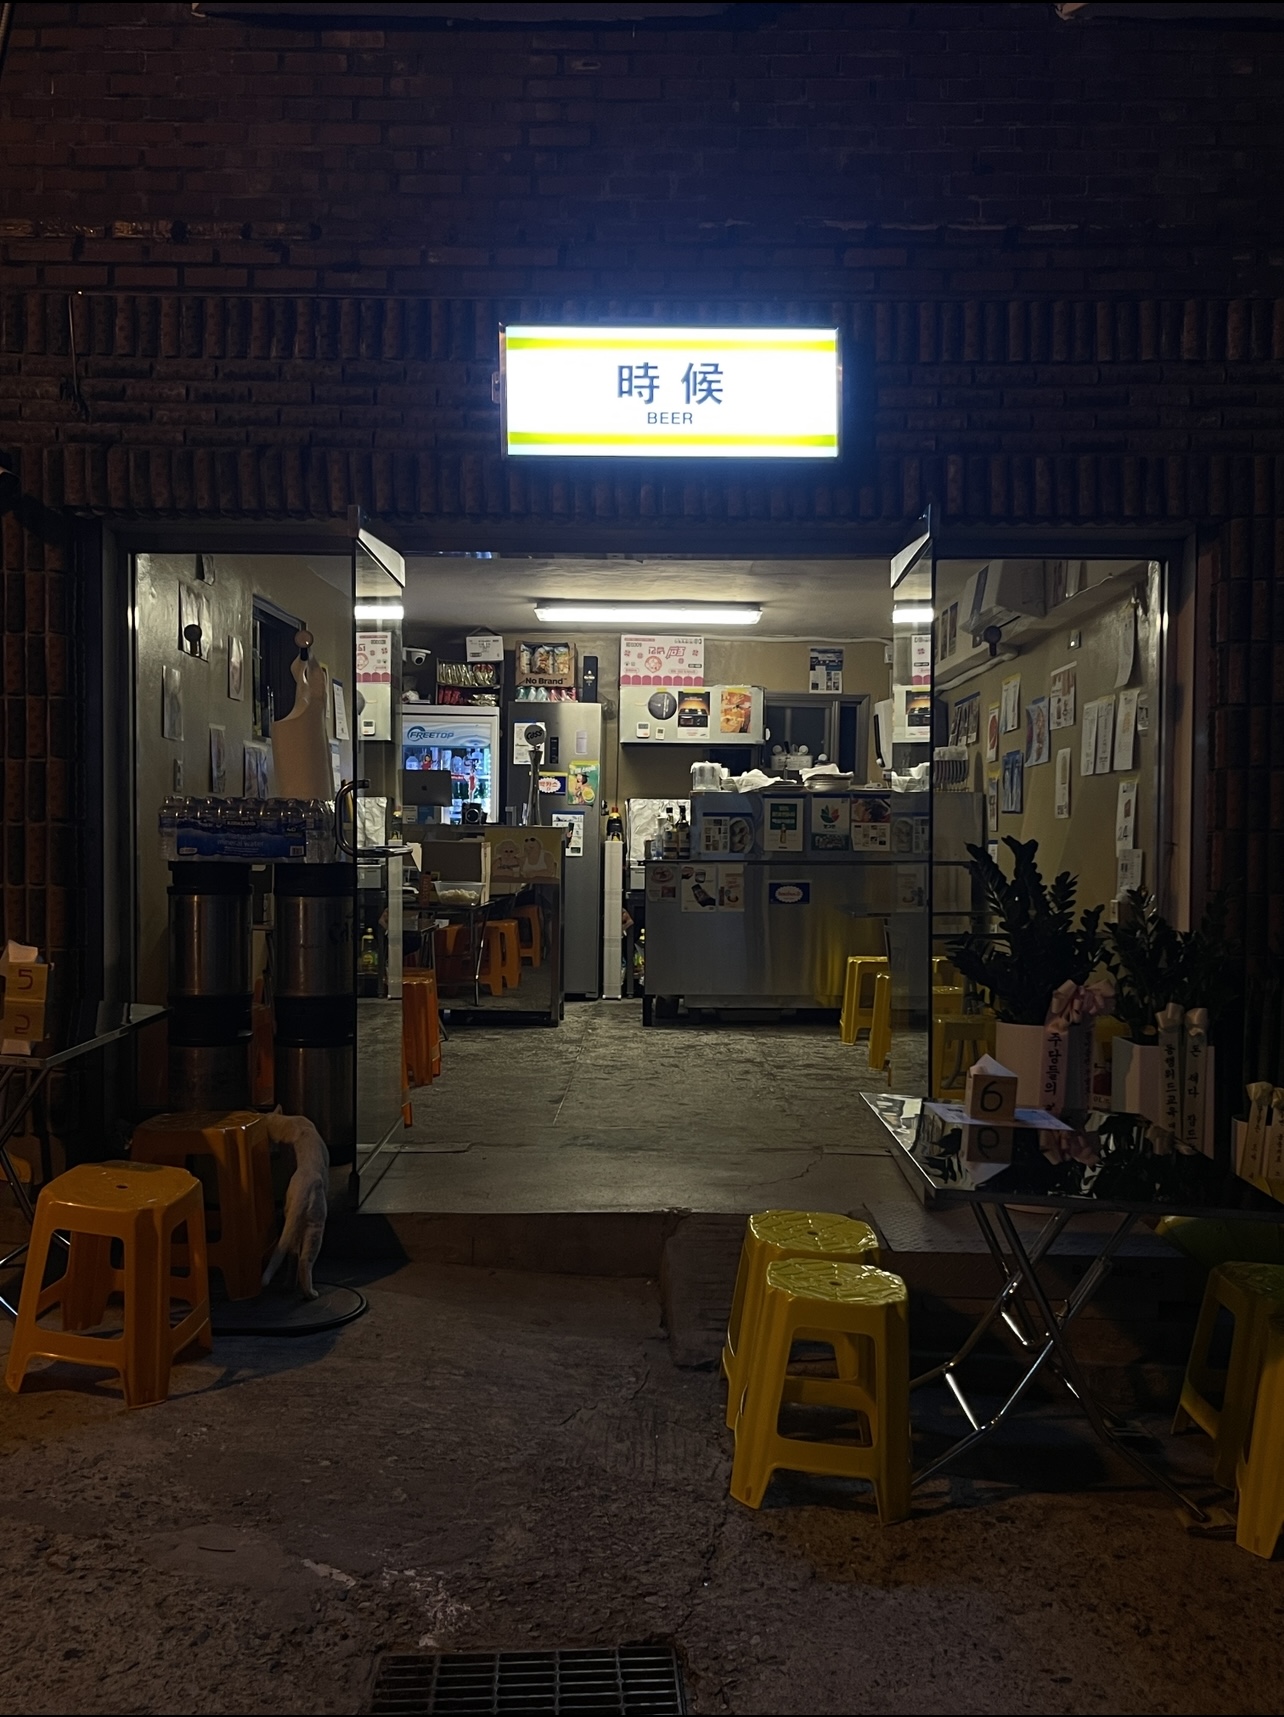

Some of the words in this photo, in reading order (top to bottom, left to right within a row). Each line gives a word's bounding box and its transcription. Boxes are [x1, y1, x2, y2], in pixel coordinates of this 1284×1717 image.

[617, 362, 724, 405] 時候
[647, 412, 693, 425] BEER
[525, 677, 537, 685] No
[538, 677, 563, 685] Brand
[409, 731, 455, 741] FREETOP
[17, 969, 33, 990] 5
[980, 1080, 1003, 1112] 6
